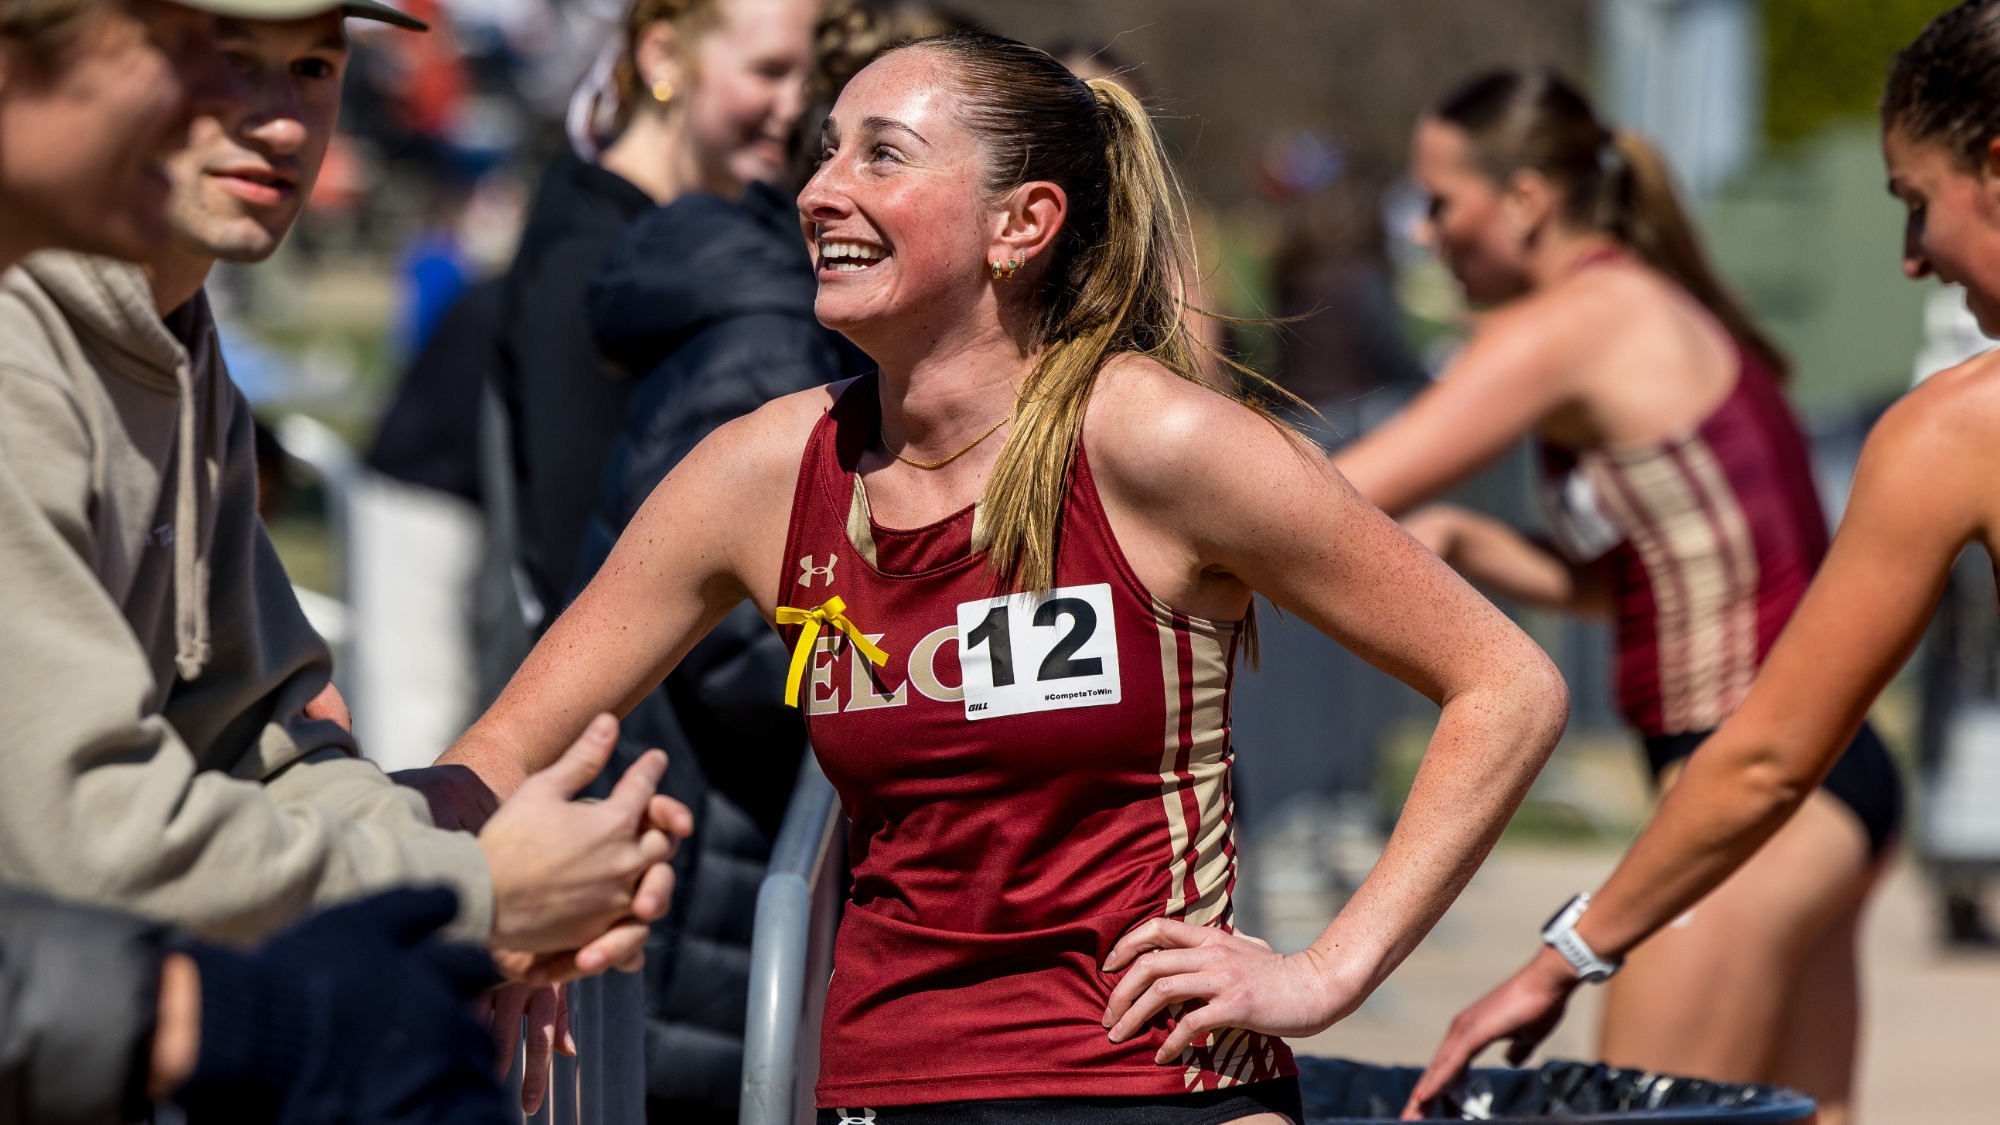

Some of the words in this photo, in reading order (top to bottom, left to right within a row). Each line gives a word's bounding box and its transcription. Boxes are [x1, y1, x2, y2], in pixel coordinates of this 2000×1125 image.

[967, 597, 1103, 688] 12
[1045, 688, 1112, 701] #CompeteToWin
[968, 702, 988, 712] GILL
